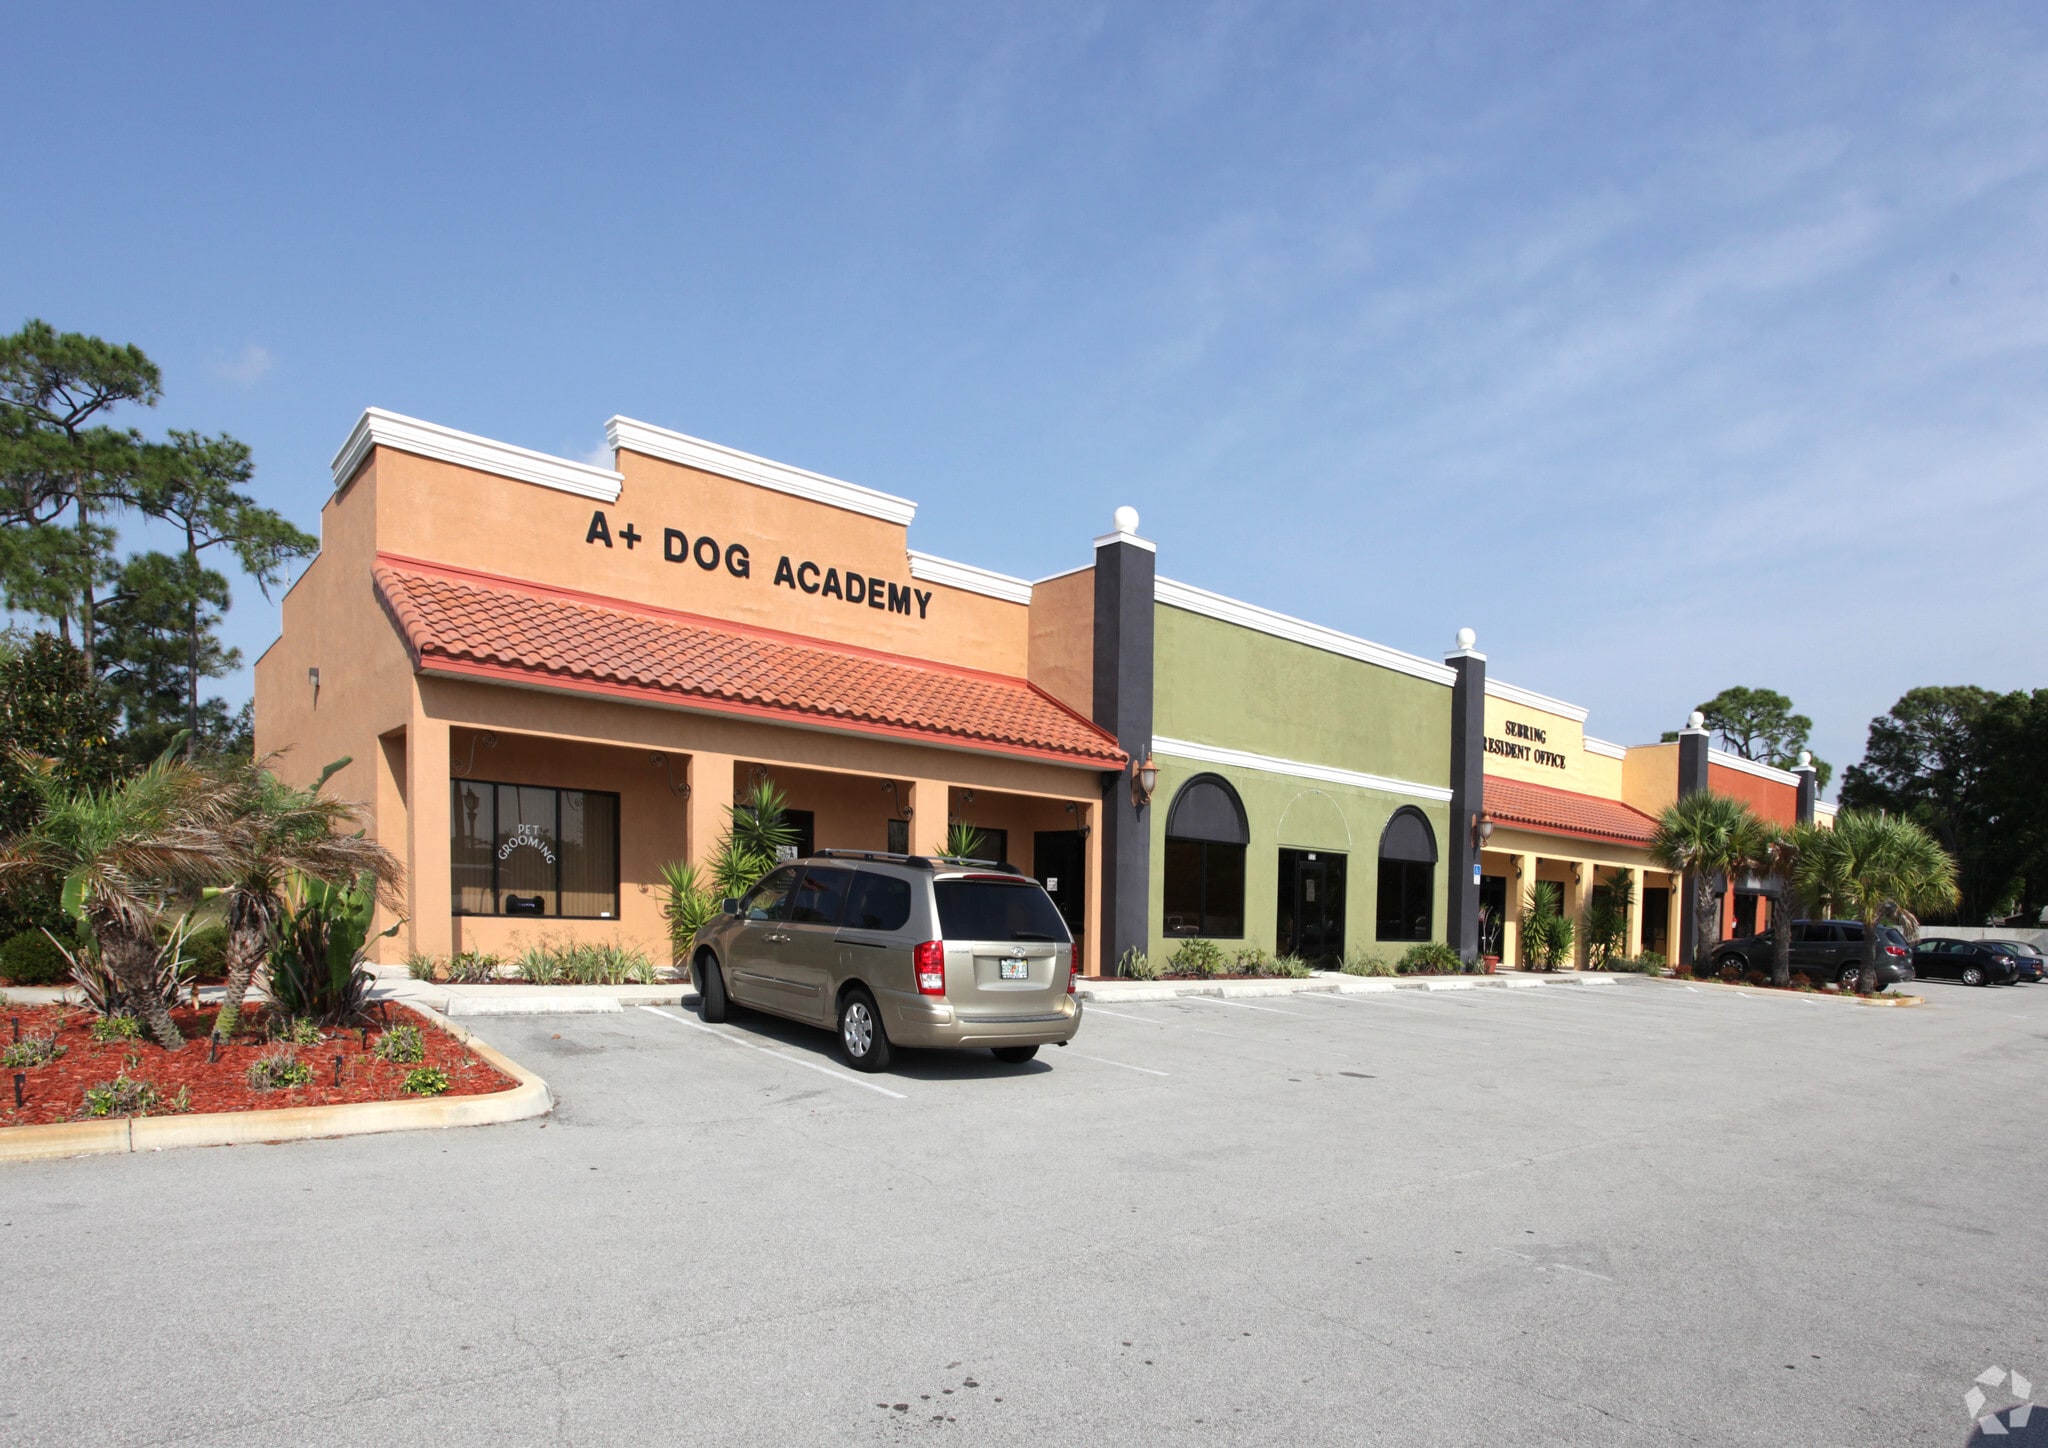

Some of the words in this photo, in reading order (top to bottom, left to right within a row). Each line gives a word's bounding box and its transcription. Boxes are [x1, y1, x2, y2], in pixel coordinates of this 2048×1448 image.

[585, 510, 642, 549] A+
[663, 527, 750, 579] DOG
[773, 555, 932, 619] ACADEMY
[1505, 720, 1546, 744] SEBRING
[1534, 749, 1566, 769] OFFICE
[518, 824, 540, 835] PET
[498, 835, 556, 864] GROOMING
